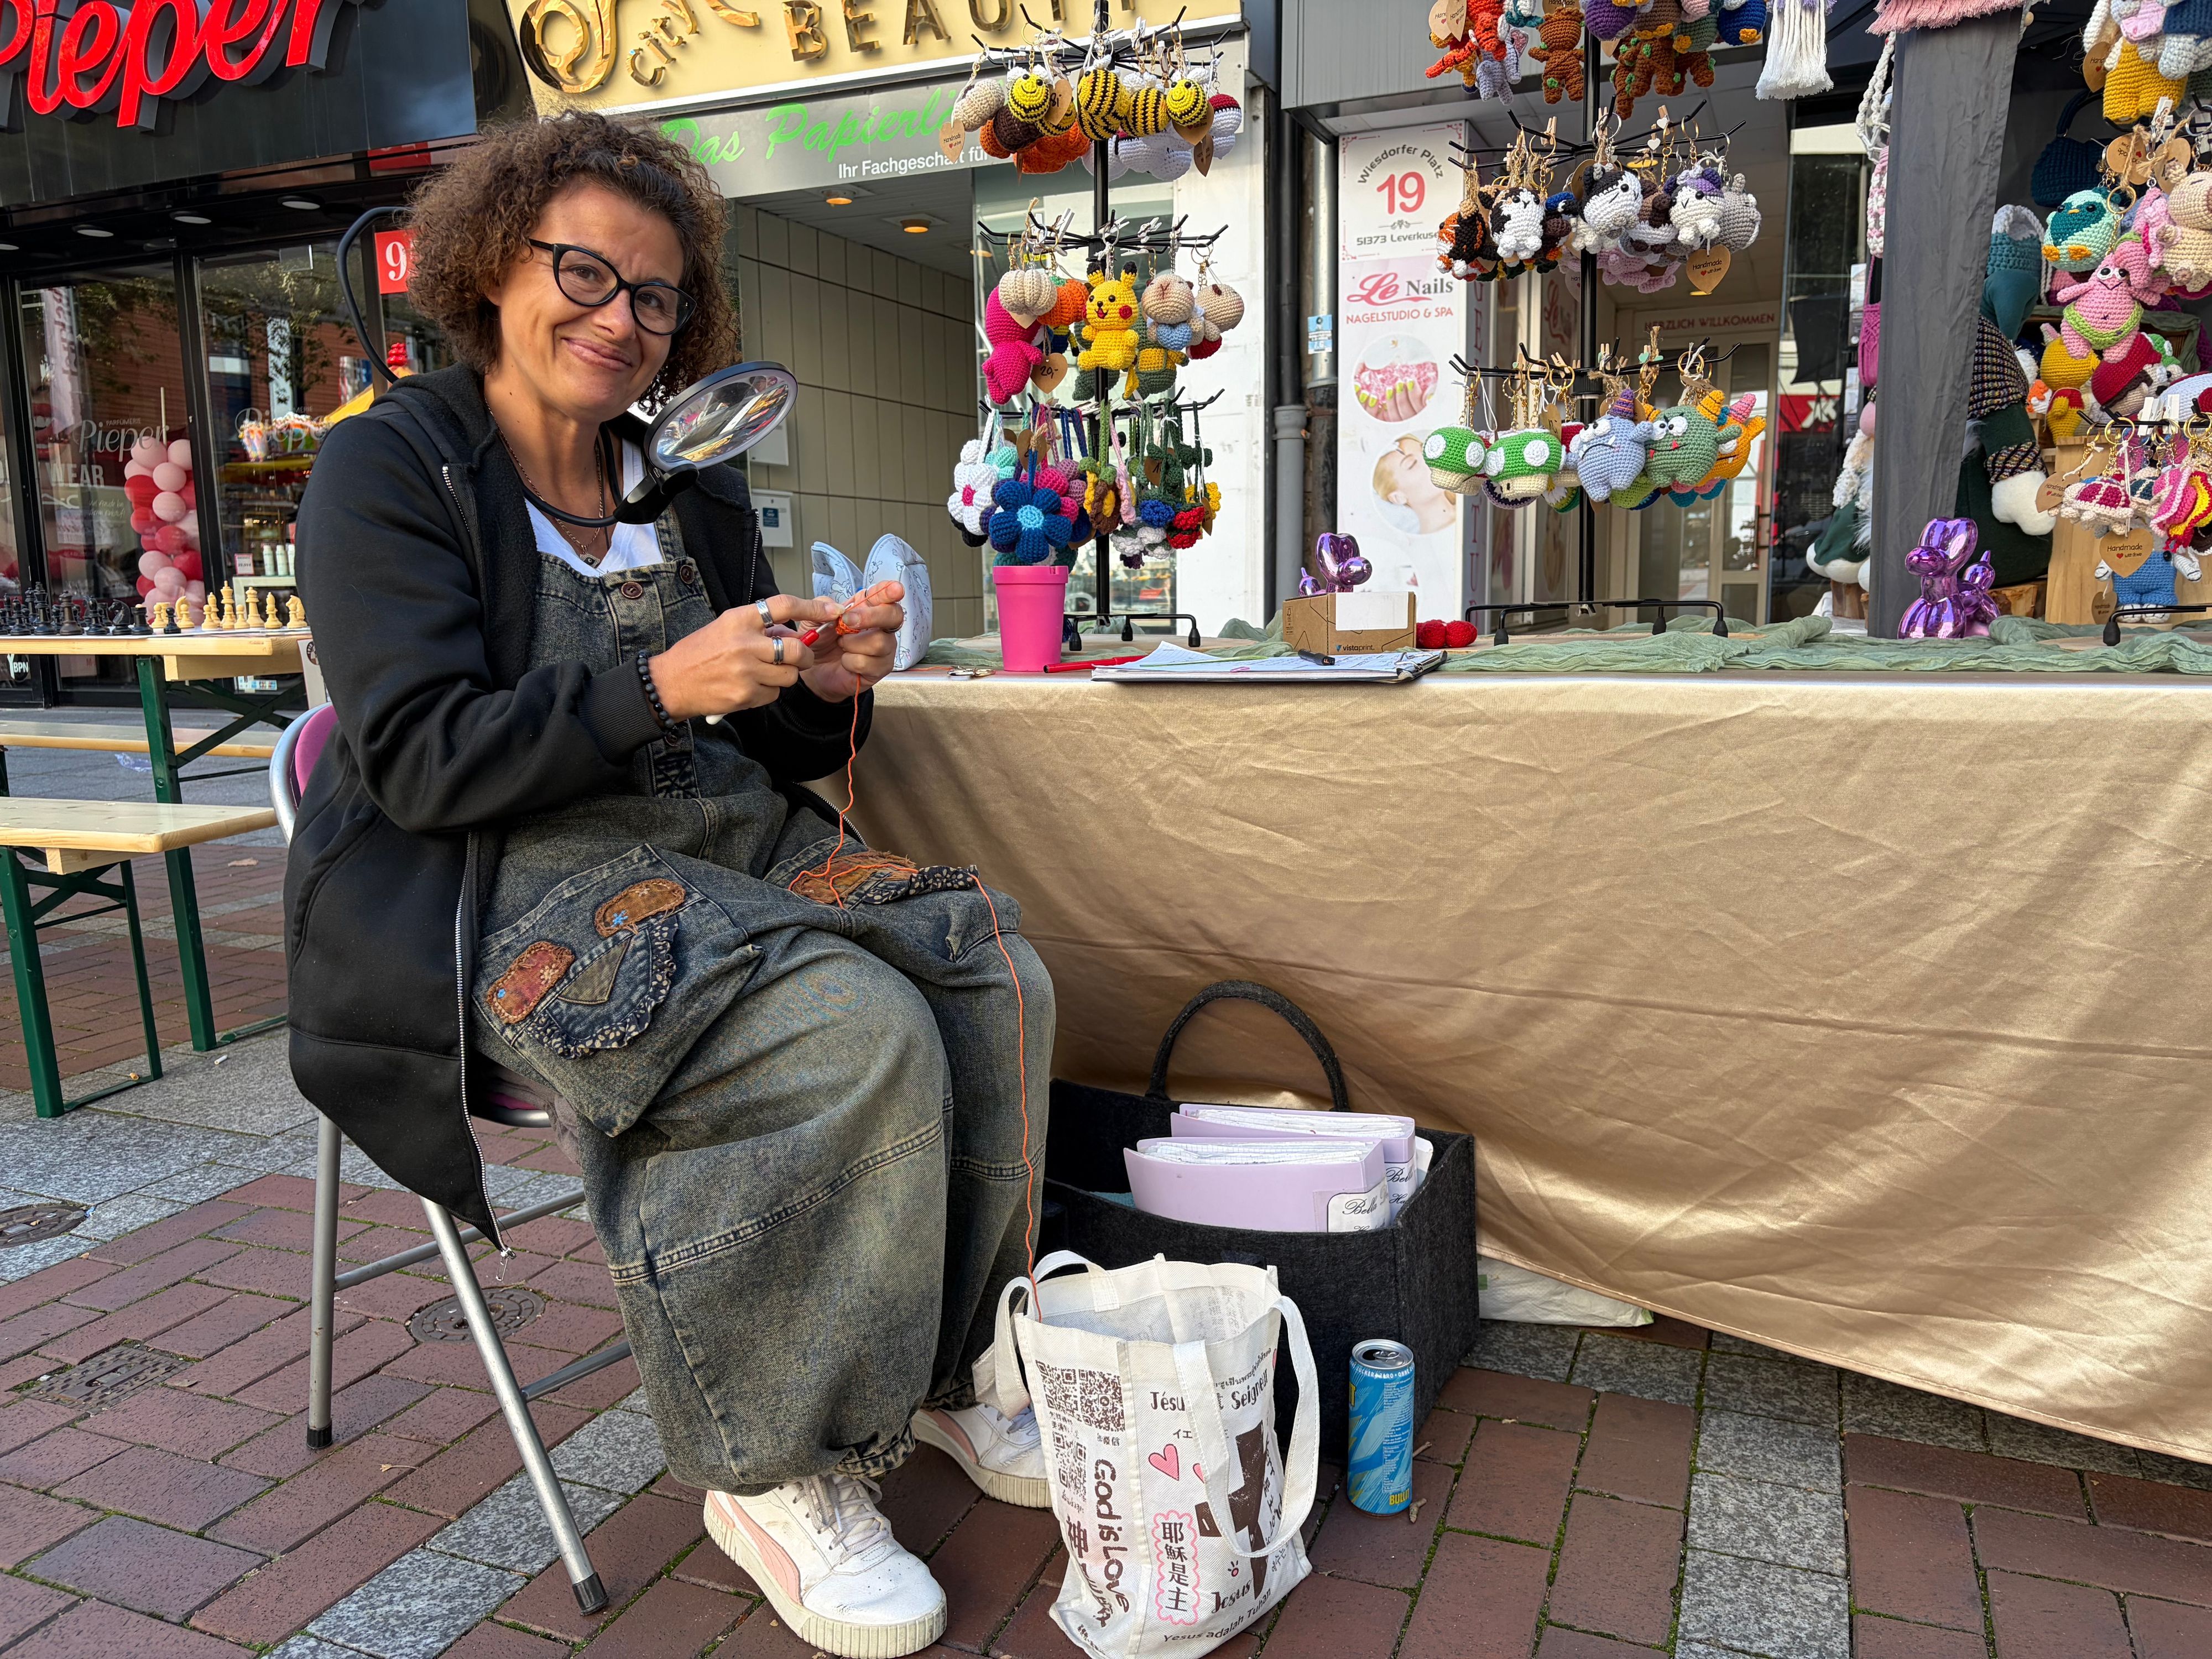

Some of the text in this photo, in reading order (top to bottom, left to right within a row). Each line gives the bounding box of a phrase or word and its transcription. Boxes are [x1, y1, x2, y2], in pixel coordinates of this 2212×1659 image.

[782, 0, 1134, 61] BEAU
[838, 163, 858, 179] Ihr
[1358, 144, 1443, 184] Wiesdorfer Platz
[1376, 171, 1425, 215] 19
[1357, 231, 1439, 246] 51373 Leverkuse
[1692, 259, 1722, 270] Handmade
[1347, 273, 1453, 306] Le Nails
[1346, 307, 1453, 324] NAGELSTUDIO & SPA
[1699, 314, 1775, 328] WILLKOMMEN
[72, 419, 170, 462] Pieper
[2107, 543, 2143, 552] Handmade
[1342, 1196, 1378, 1215] Bella
[1150, 1391, 1186, 1411] Jésu
[1231, 1369, 1268, 1410] Seigneur
[1094, 1458, 1122, 1520] God
[1211, 1578, 1251, 1614] Jesus
[1164, 1588, 1272, 1642] Yesus adalah Tuhan
